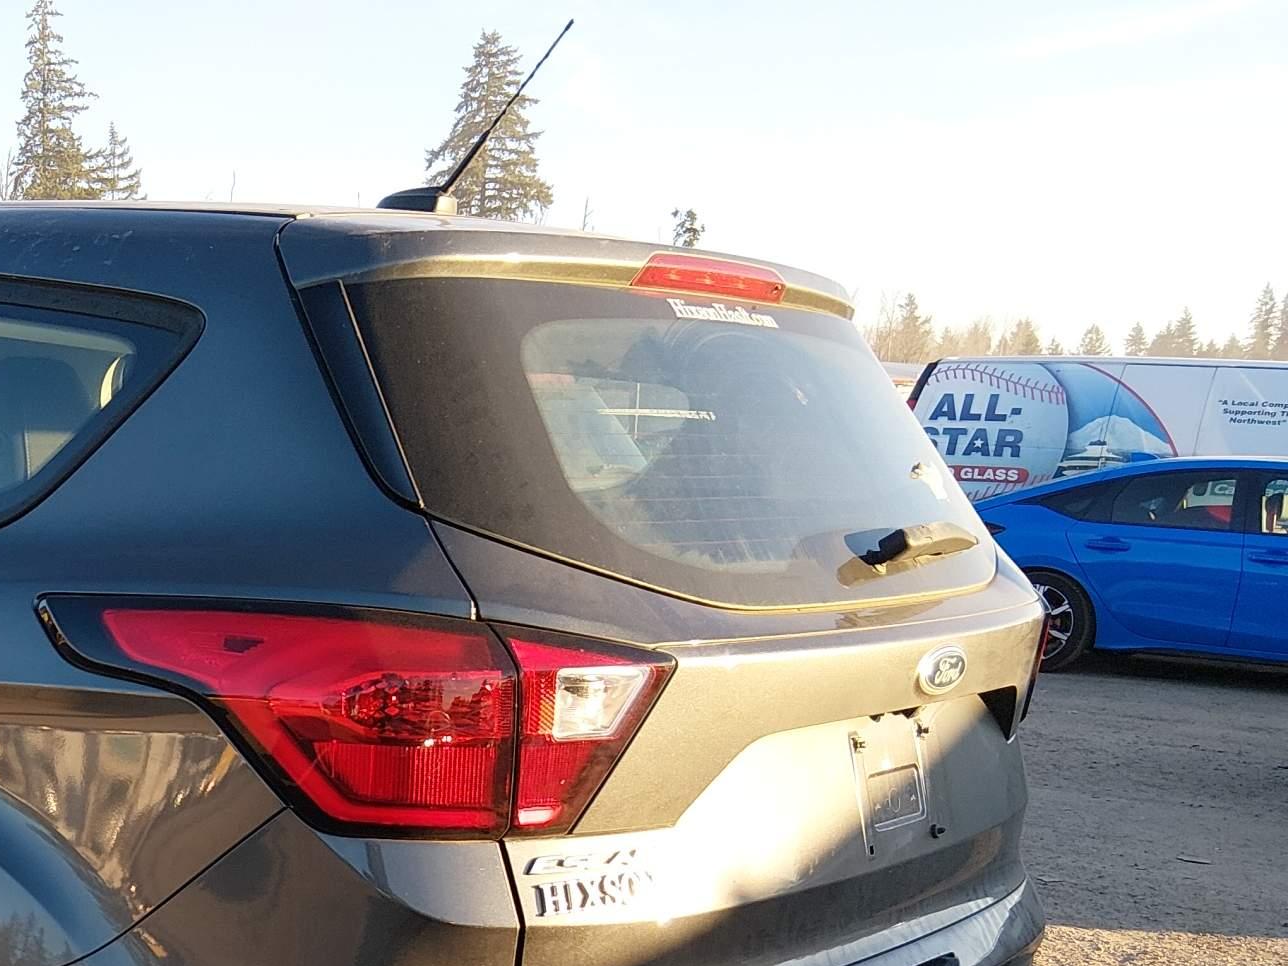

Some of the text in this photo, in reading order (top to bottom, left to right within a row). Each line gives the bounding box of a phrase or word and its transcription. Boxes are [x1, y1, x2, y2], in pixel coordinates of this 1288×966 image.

[928, 393, 1022, 422] ALL-
[1223, 408, 1277, 418] Supporting
[959, 467, 1019, 481] GLASS
[934, 656, 962, 684] Ford
